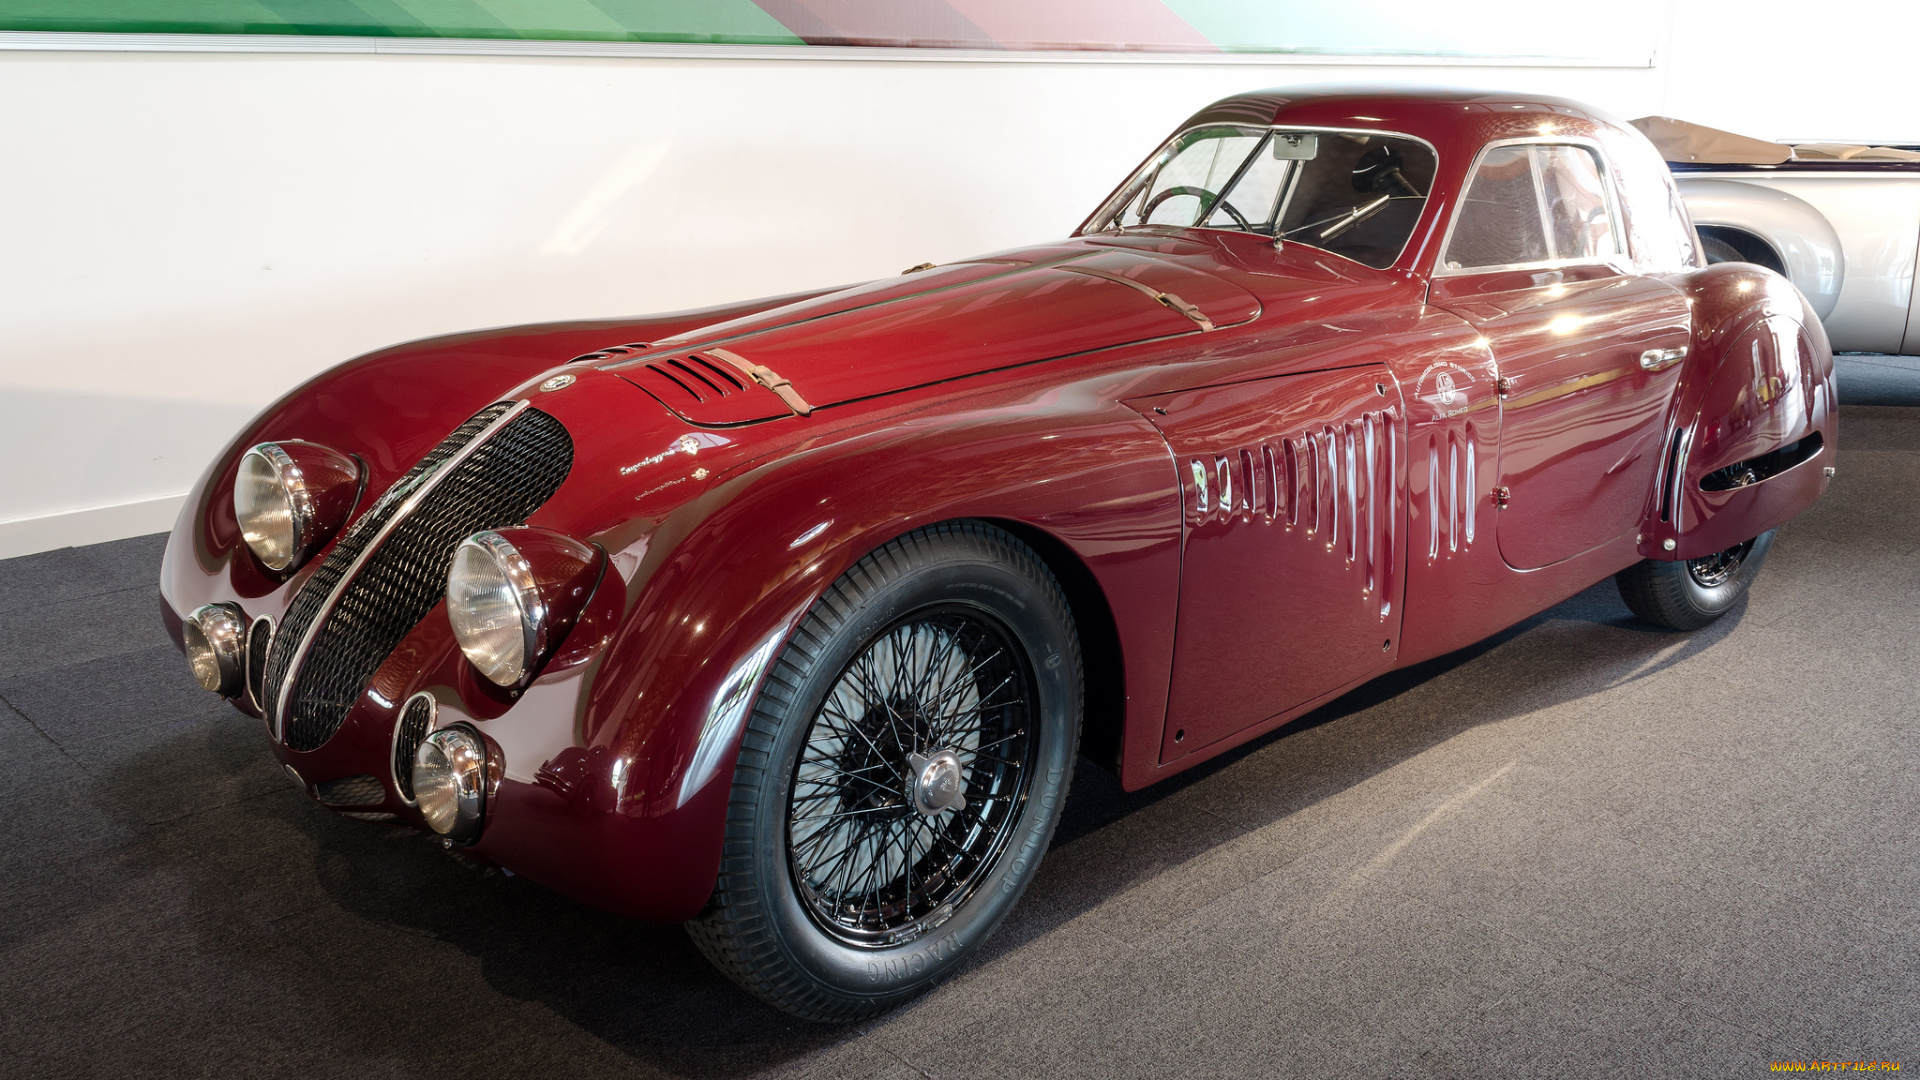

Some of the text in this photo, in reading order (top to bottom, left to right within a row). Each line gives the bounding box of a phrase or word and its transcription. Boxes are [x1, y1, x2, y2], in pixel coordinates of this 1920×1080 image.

[1449, 362, 1476, 383] STORICO
[1432, 413, 1447, 421] ALFA
[1000, 766, 1064, 895] DUNLOP
[866, 929, 963, 983] RACING
